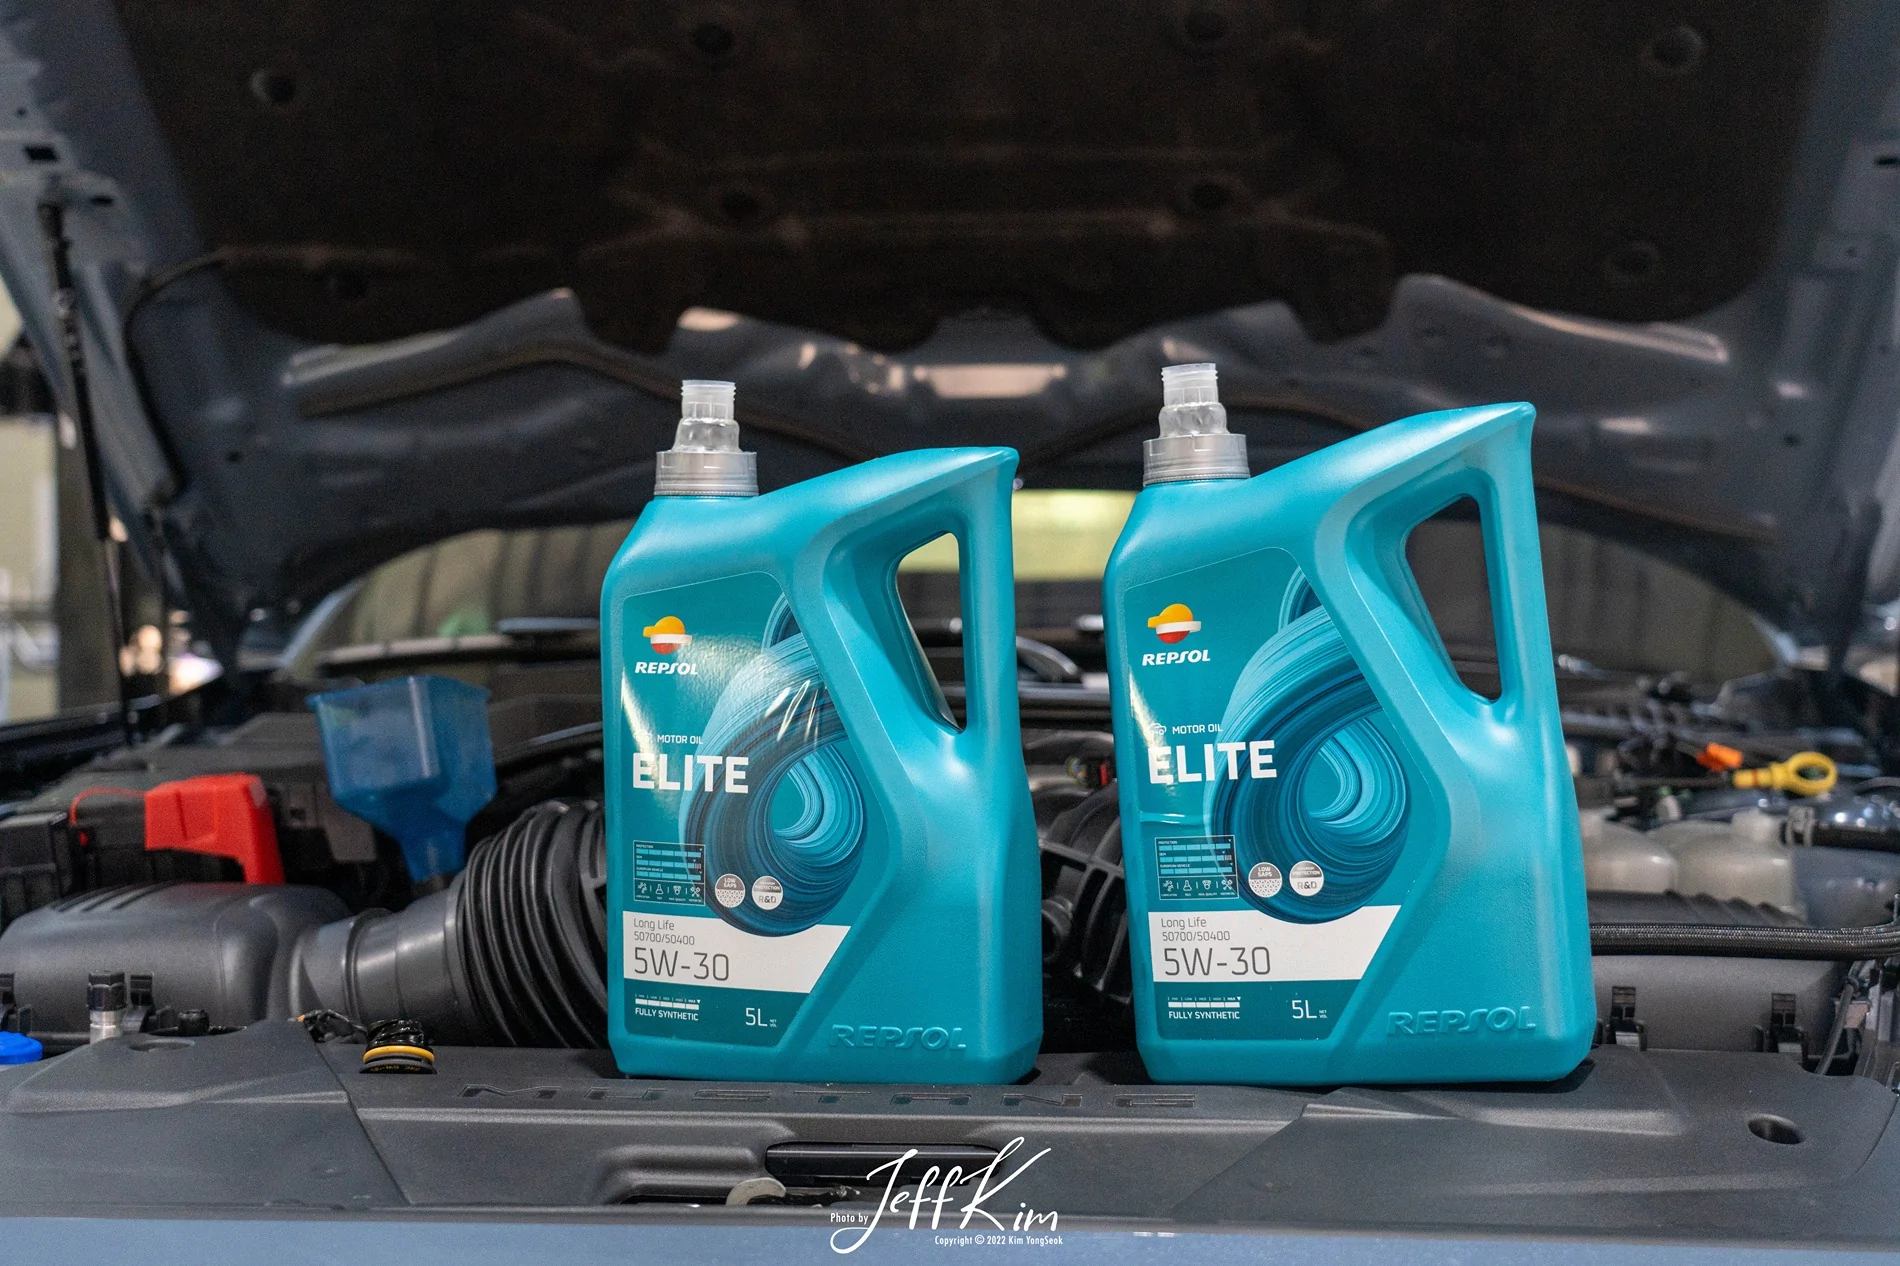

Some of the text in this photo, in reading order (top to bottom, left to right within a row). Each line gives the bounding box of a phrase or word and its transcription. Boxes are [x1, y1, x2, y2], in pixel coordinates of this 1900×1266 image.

[1142, 649, 1211, 666] REPSOL
[634, 661, 698, 675] REPSOL
[1172, 723, 1223, 735] MOTOR OIL
[657, 735, 703, 745] MOTOR OIL
[1147, 740, 1277, 784] ELITE
[632, 752, 749, 793] ELITE
[633, 918, 675, 931] Long Life
[1161, 917, 1207, 930] Long Life
[634, 931, 695, 945] 50700/50400
[1162, 930, 1230, 941] 50700/50400
[634, 947, 729, 981] 5W-30
[1164, 946, 1271, 976] 5W-30
[635, 1007, 699, 1021] FULLY SYNTHETIC
[745, 1007, 768, 1026] 5L
[1168, 1011, 1240, 1020] FULLY SYNTHETIC
[1292, 1000, 1317, 1019] 5L
[1387, 1005, 1537, 1036] REPSOL
[828, 1024, 967, 1050] REPSOL
